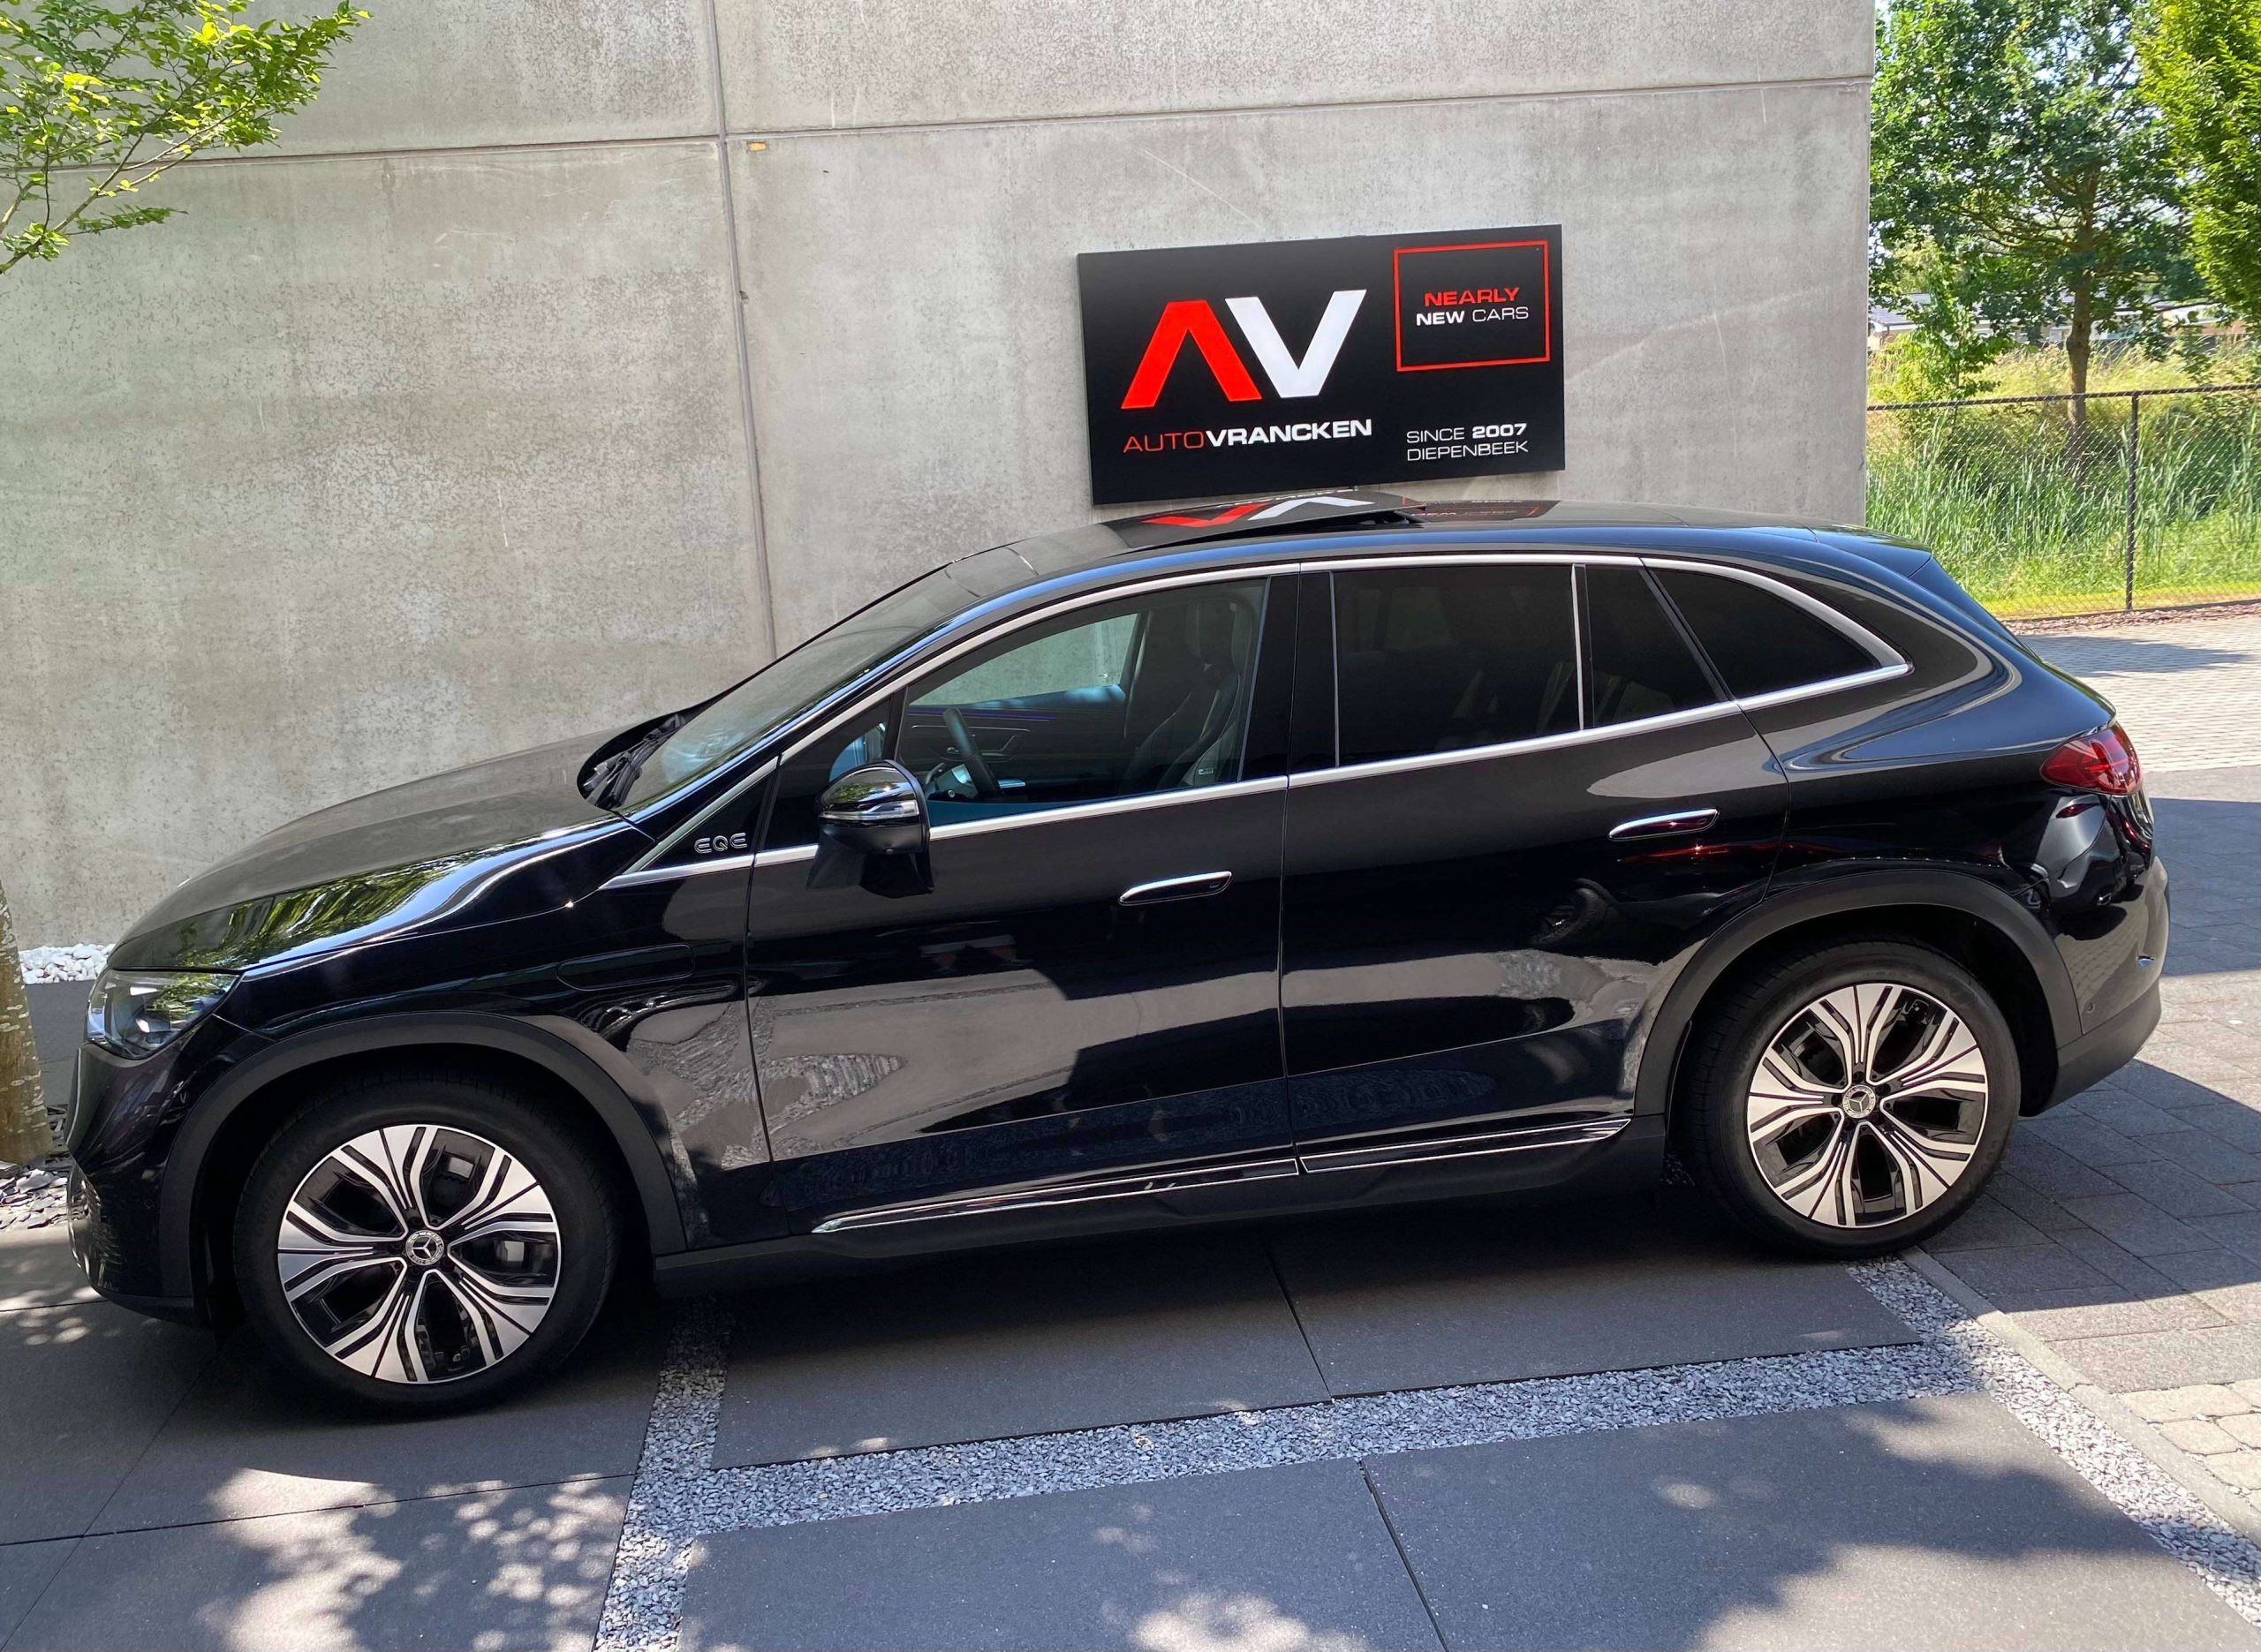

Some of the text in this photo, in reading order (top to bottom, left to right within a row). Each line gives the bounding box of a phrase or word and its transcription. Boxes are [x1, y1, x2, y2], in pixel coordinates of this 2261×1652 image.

[1424, 286, 1520, 306] NEARLY
[1416, 306, 1529, 326] NEW CARS
[1121, 289, 1367, 409] AV
[1123, 419, 1372, 453] AUTOVRANCKEN
[1406, 423, 1527, 443] SINCE 2007
[1407, 441, 1529, 461] DIEPENBEEK
[694, 832, 748, 854] EQE
